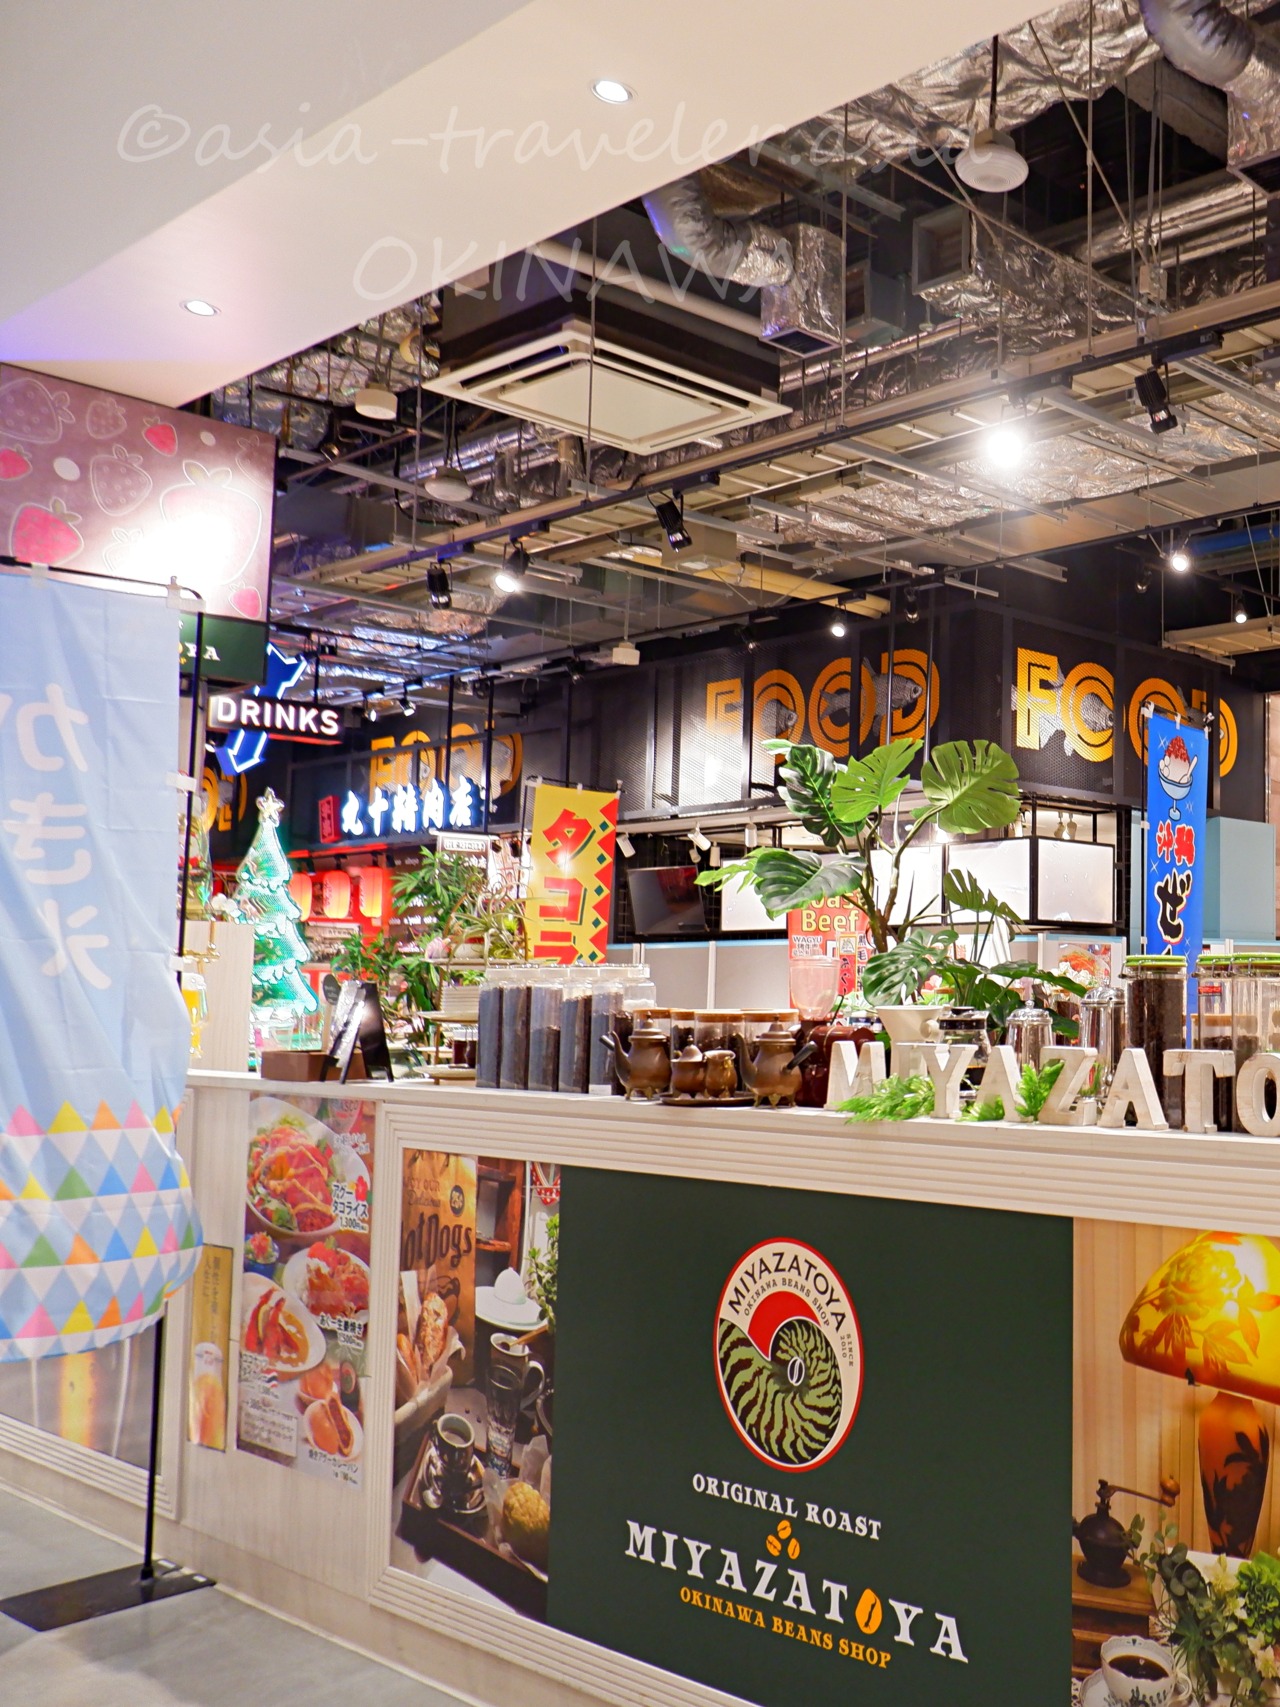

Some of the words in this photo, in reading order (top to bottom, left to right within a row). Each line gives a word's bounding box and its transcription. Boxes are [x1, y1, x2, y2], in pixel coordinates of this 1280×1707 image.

[217, 696, 340, 736] DRINKS
[705, 647, 941, 763] FOOD
[1015, 647, 1239, 779] FOOD
[792, 935, 823, 944] WAGYU
[801, 909, 859, 933] Beef
[1154, 868, 1193, 955] ぜ
[332, 1200, 368, 1217] タコライス
[728, 1251, 847, 1334] MIYAZATOYA
[744, 1278, 778, 1317] OKINAWA
[781, 1277, 811, 1298] BEANS
[812, 1297, 830, 1327] SHOP
[846, 1333, 854, 1367] SINCE
[692, 1472, 798, 1518] ORIGINAL
[805, 1502, 882, 1541] ROAST
[625, 1519, 969, 1664] MIYAZATOYA
[680, 1586, 765, 1628] OKINAWA
[772, 1616, 833, 1650] BEANS
[838, 1638, 892, 1669] SHOP
